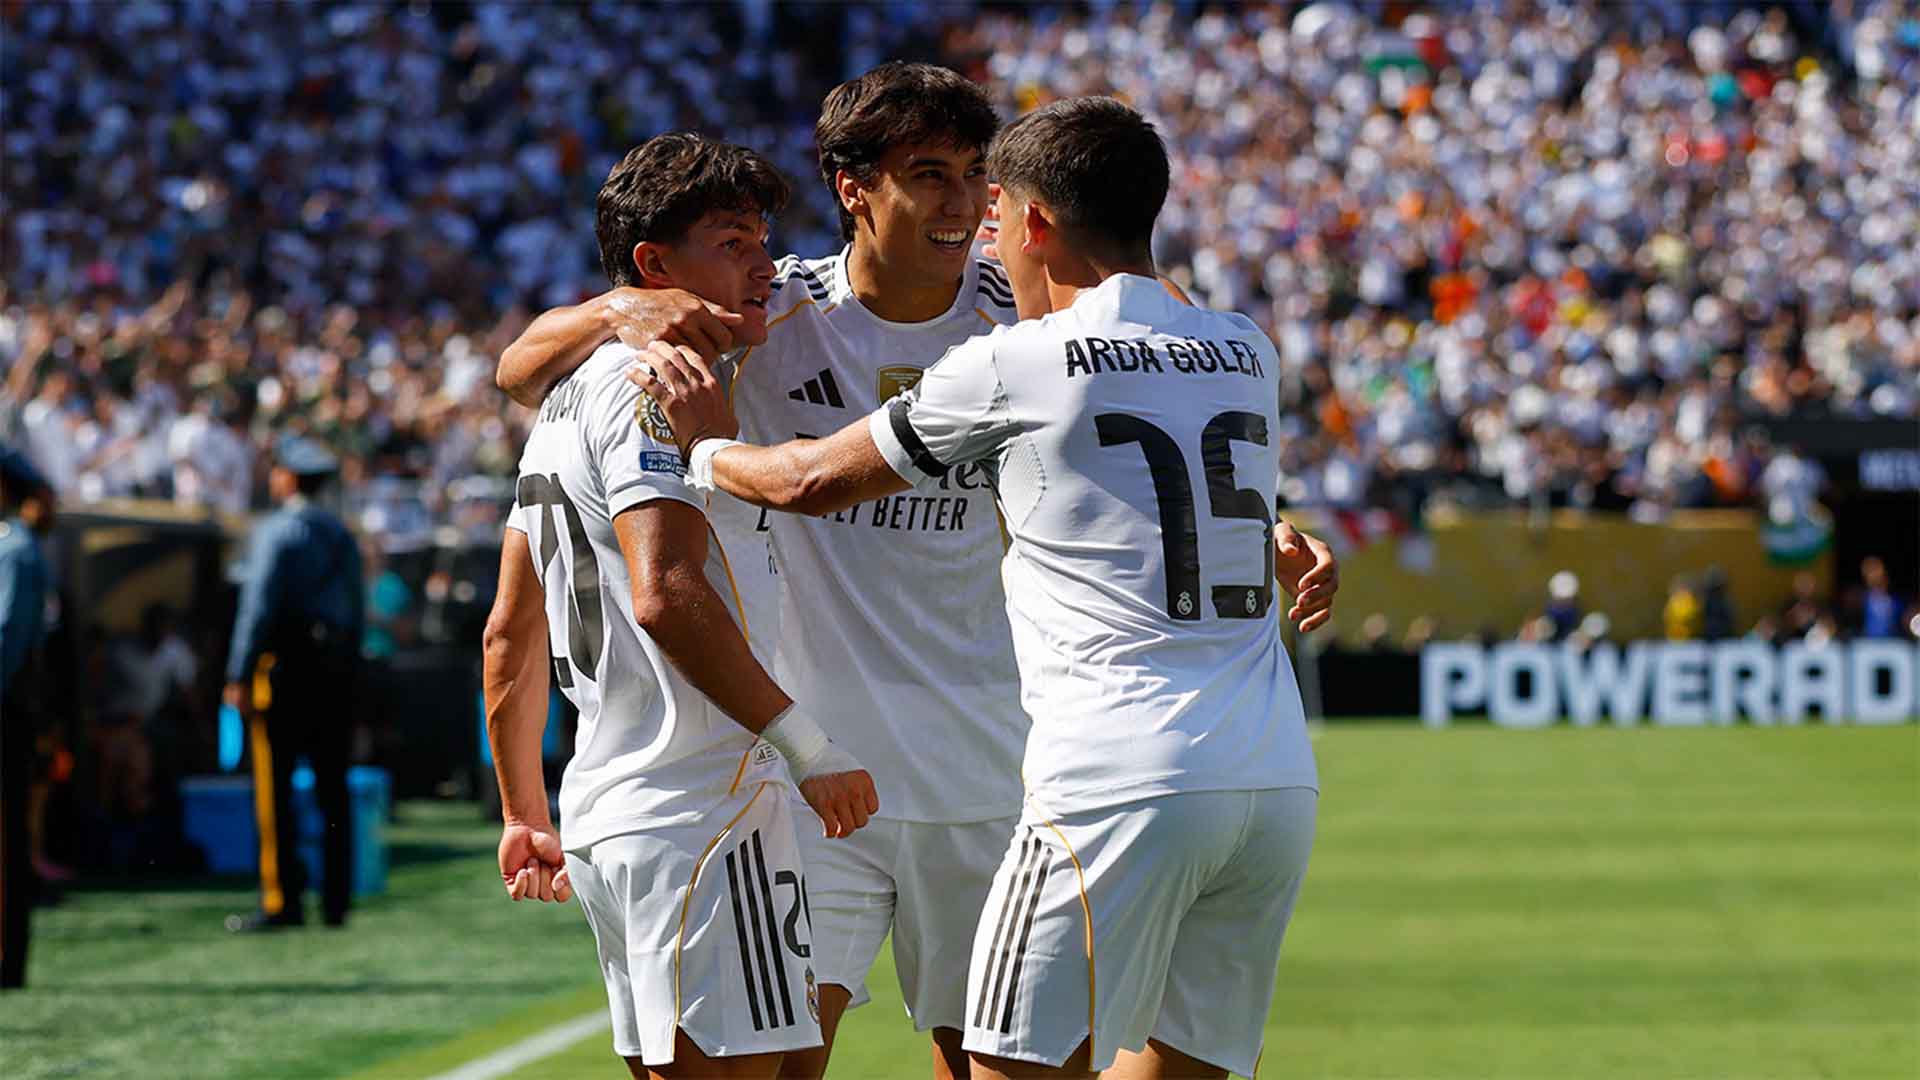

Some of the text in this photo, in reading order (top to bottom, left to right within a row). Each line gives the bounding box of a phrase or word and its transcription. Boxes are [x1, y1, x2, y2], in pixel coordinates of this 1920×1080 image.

[1064, 336, 1265, 378] ARDA GÜLER
[872, 496, 968, 531] BETTER
[1094, 410, 1275, 621] 15
[1420, 640, 1920, 726] POWERAD
[775, 870, 813, 958] 2
